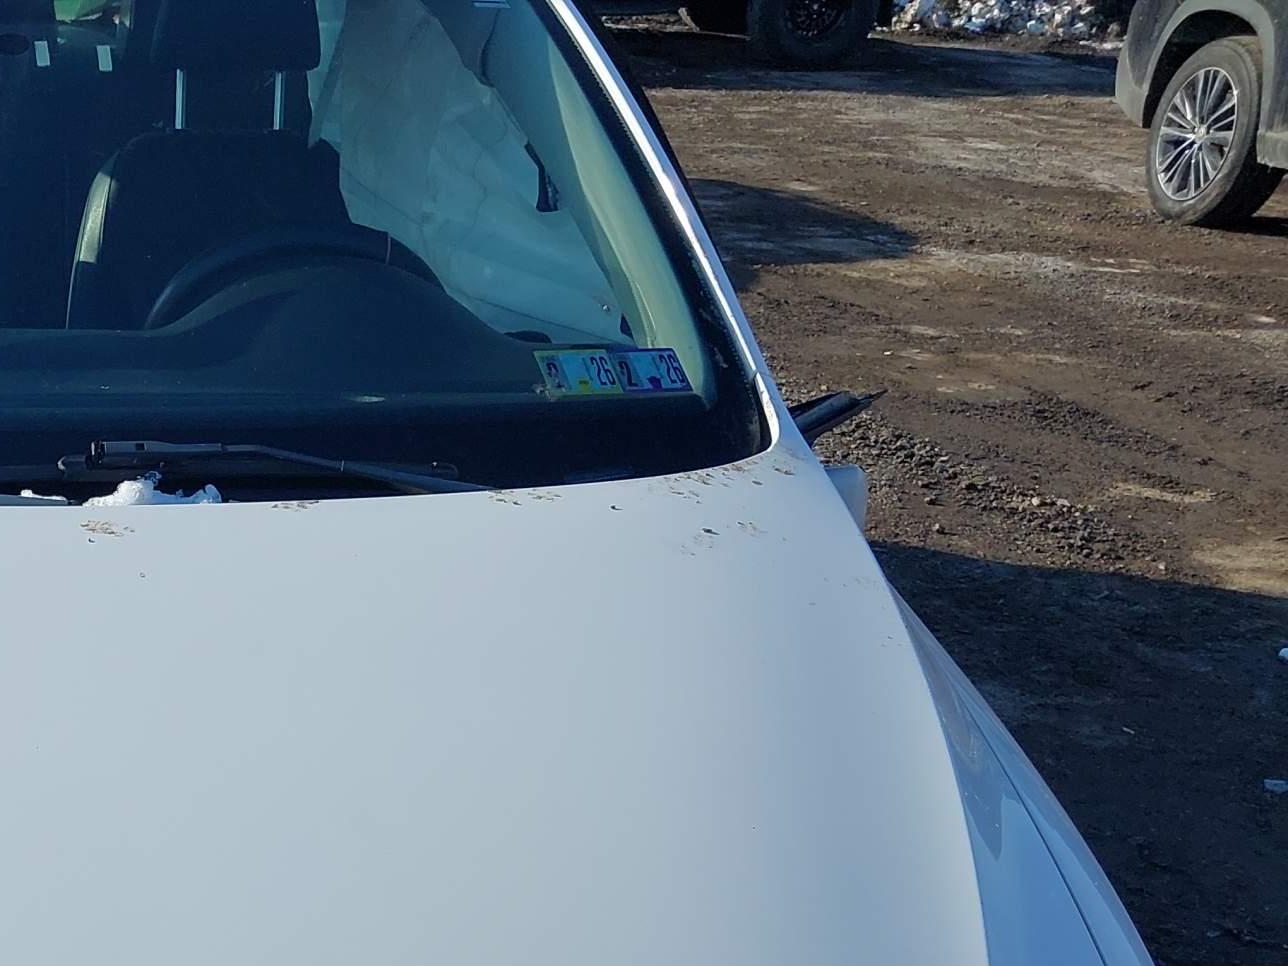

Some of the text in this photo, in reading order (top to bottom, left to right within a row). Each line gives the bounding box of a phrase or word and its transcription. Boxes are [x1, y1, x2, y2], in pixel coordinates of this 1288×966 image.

[590, 356, 616, 386] 26
[617, 353, 686, 387] 2 26
